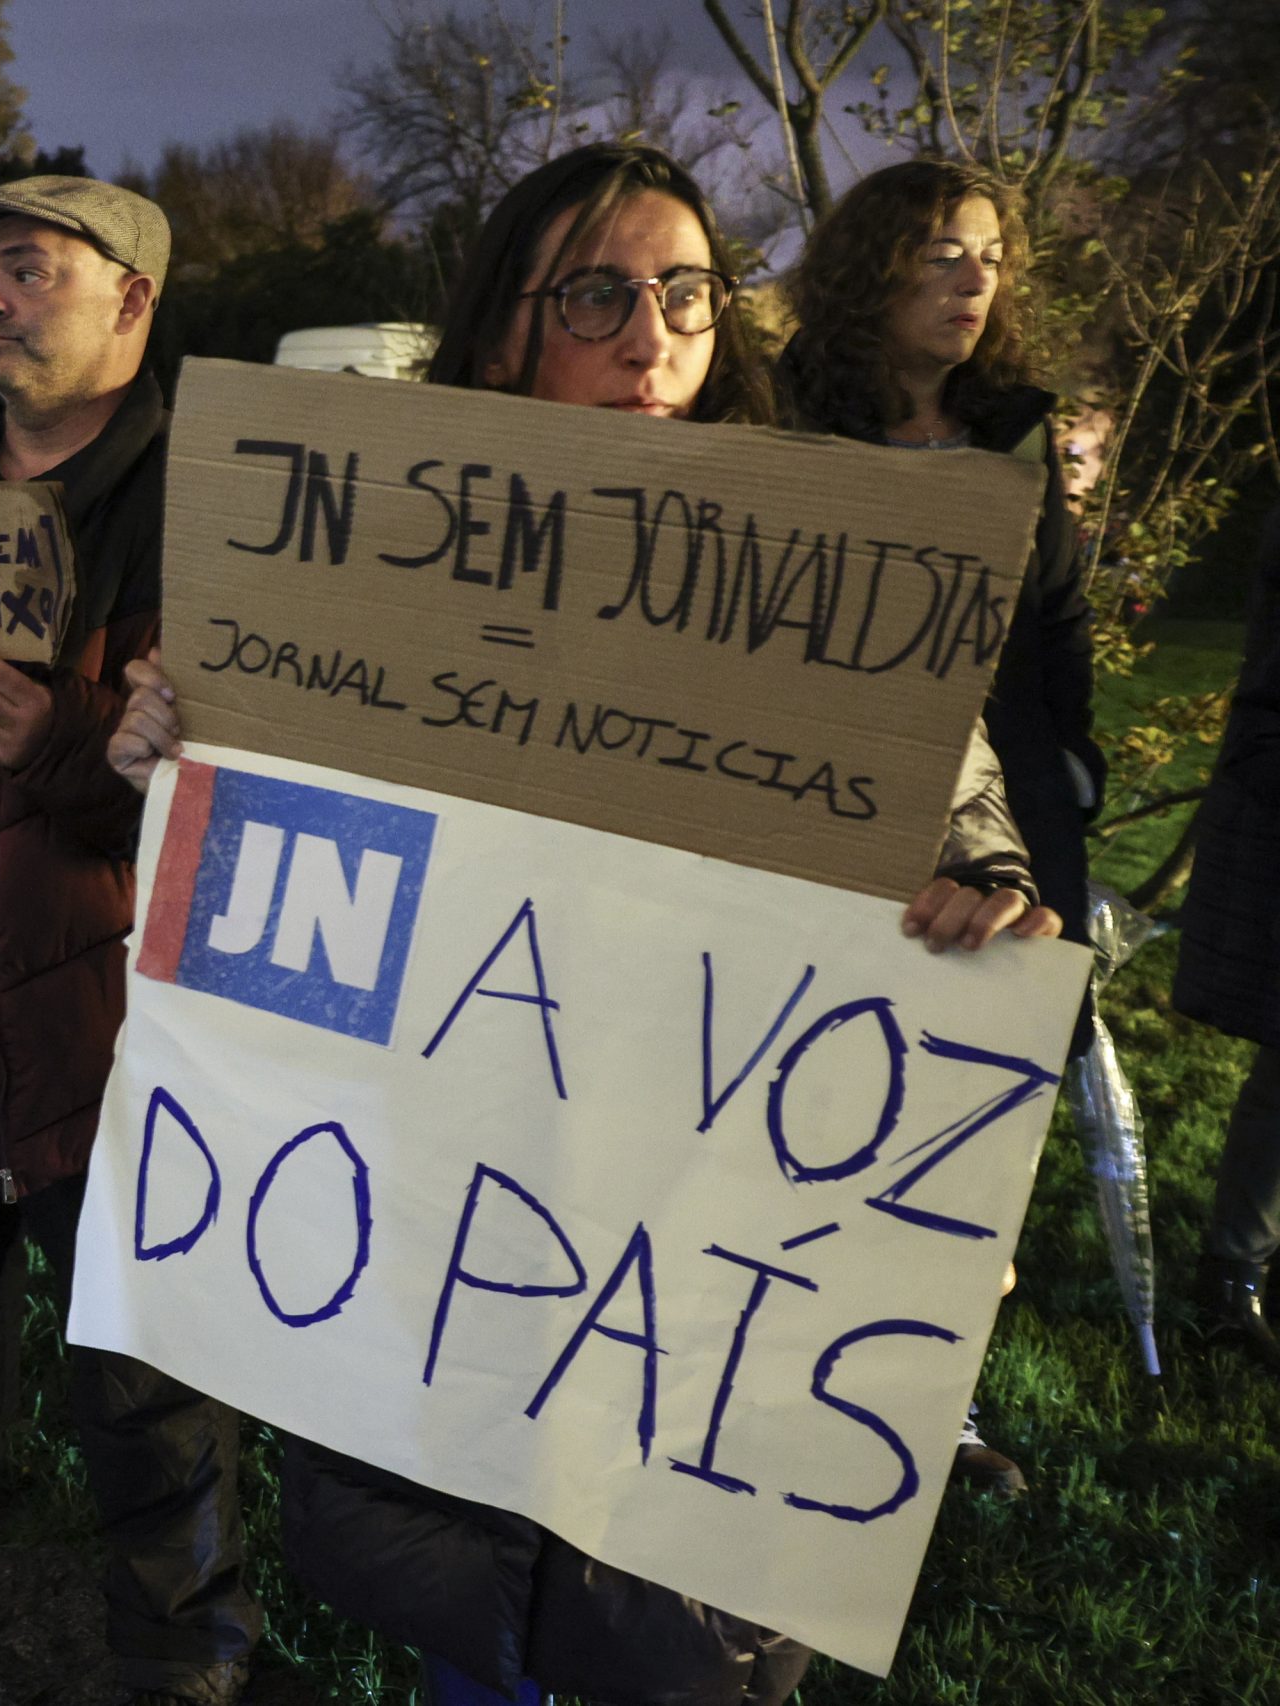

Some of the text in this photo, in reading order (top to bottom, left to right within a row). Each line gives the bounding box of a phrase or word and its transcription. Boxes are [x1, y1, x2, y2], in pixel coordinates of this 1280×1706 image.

[225, 438, 360, 567] JN
[378, 459, 568, 612] SEM
[200, 617, 879, 821] JORNAL SEM NOTICIAS
[207, 820, 403, 992] JN
[422, 898, 1061, 1240] A VOZ
[134, 1085, 964, 1524] DO PAÍS
